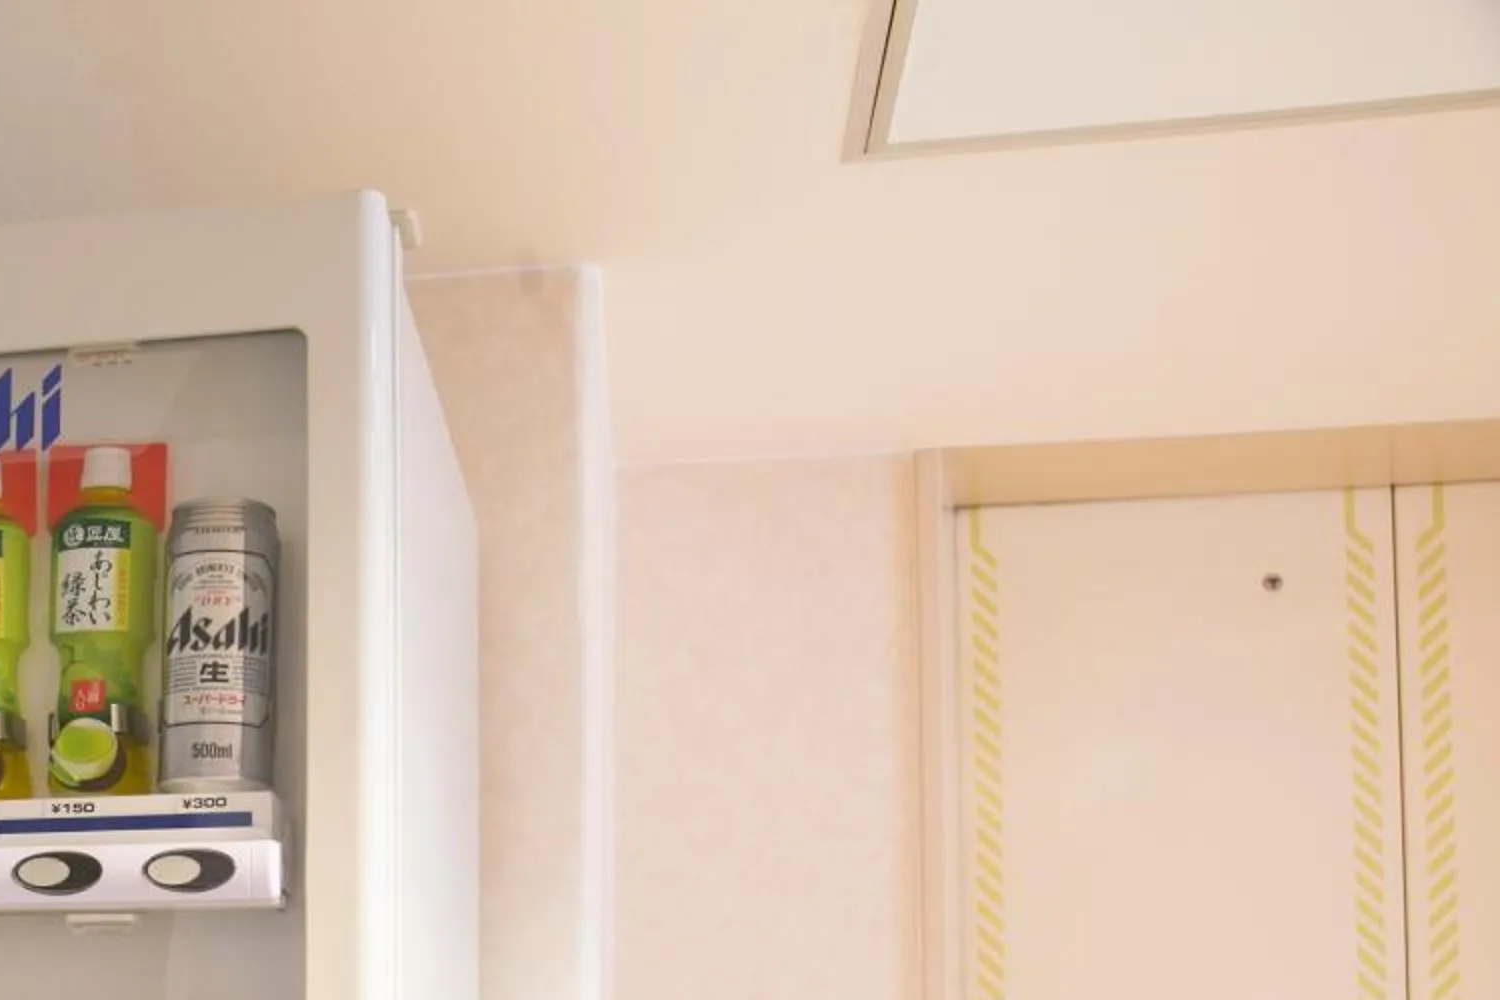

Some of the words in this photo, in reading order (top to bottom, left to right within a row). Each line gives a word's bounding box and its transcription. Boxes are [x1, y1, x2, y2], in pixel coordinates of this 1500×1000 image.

[167, 606, 270, 657] Asahi
[199, 660, 229, 683] 生
[191, 741, 234, 760] 500ml
[51, 802, 95, 814] ¥150
[182, 796, 227, 809] ¥300
